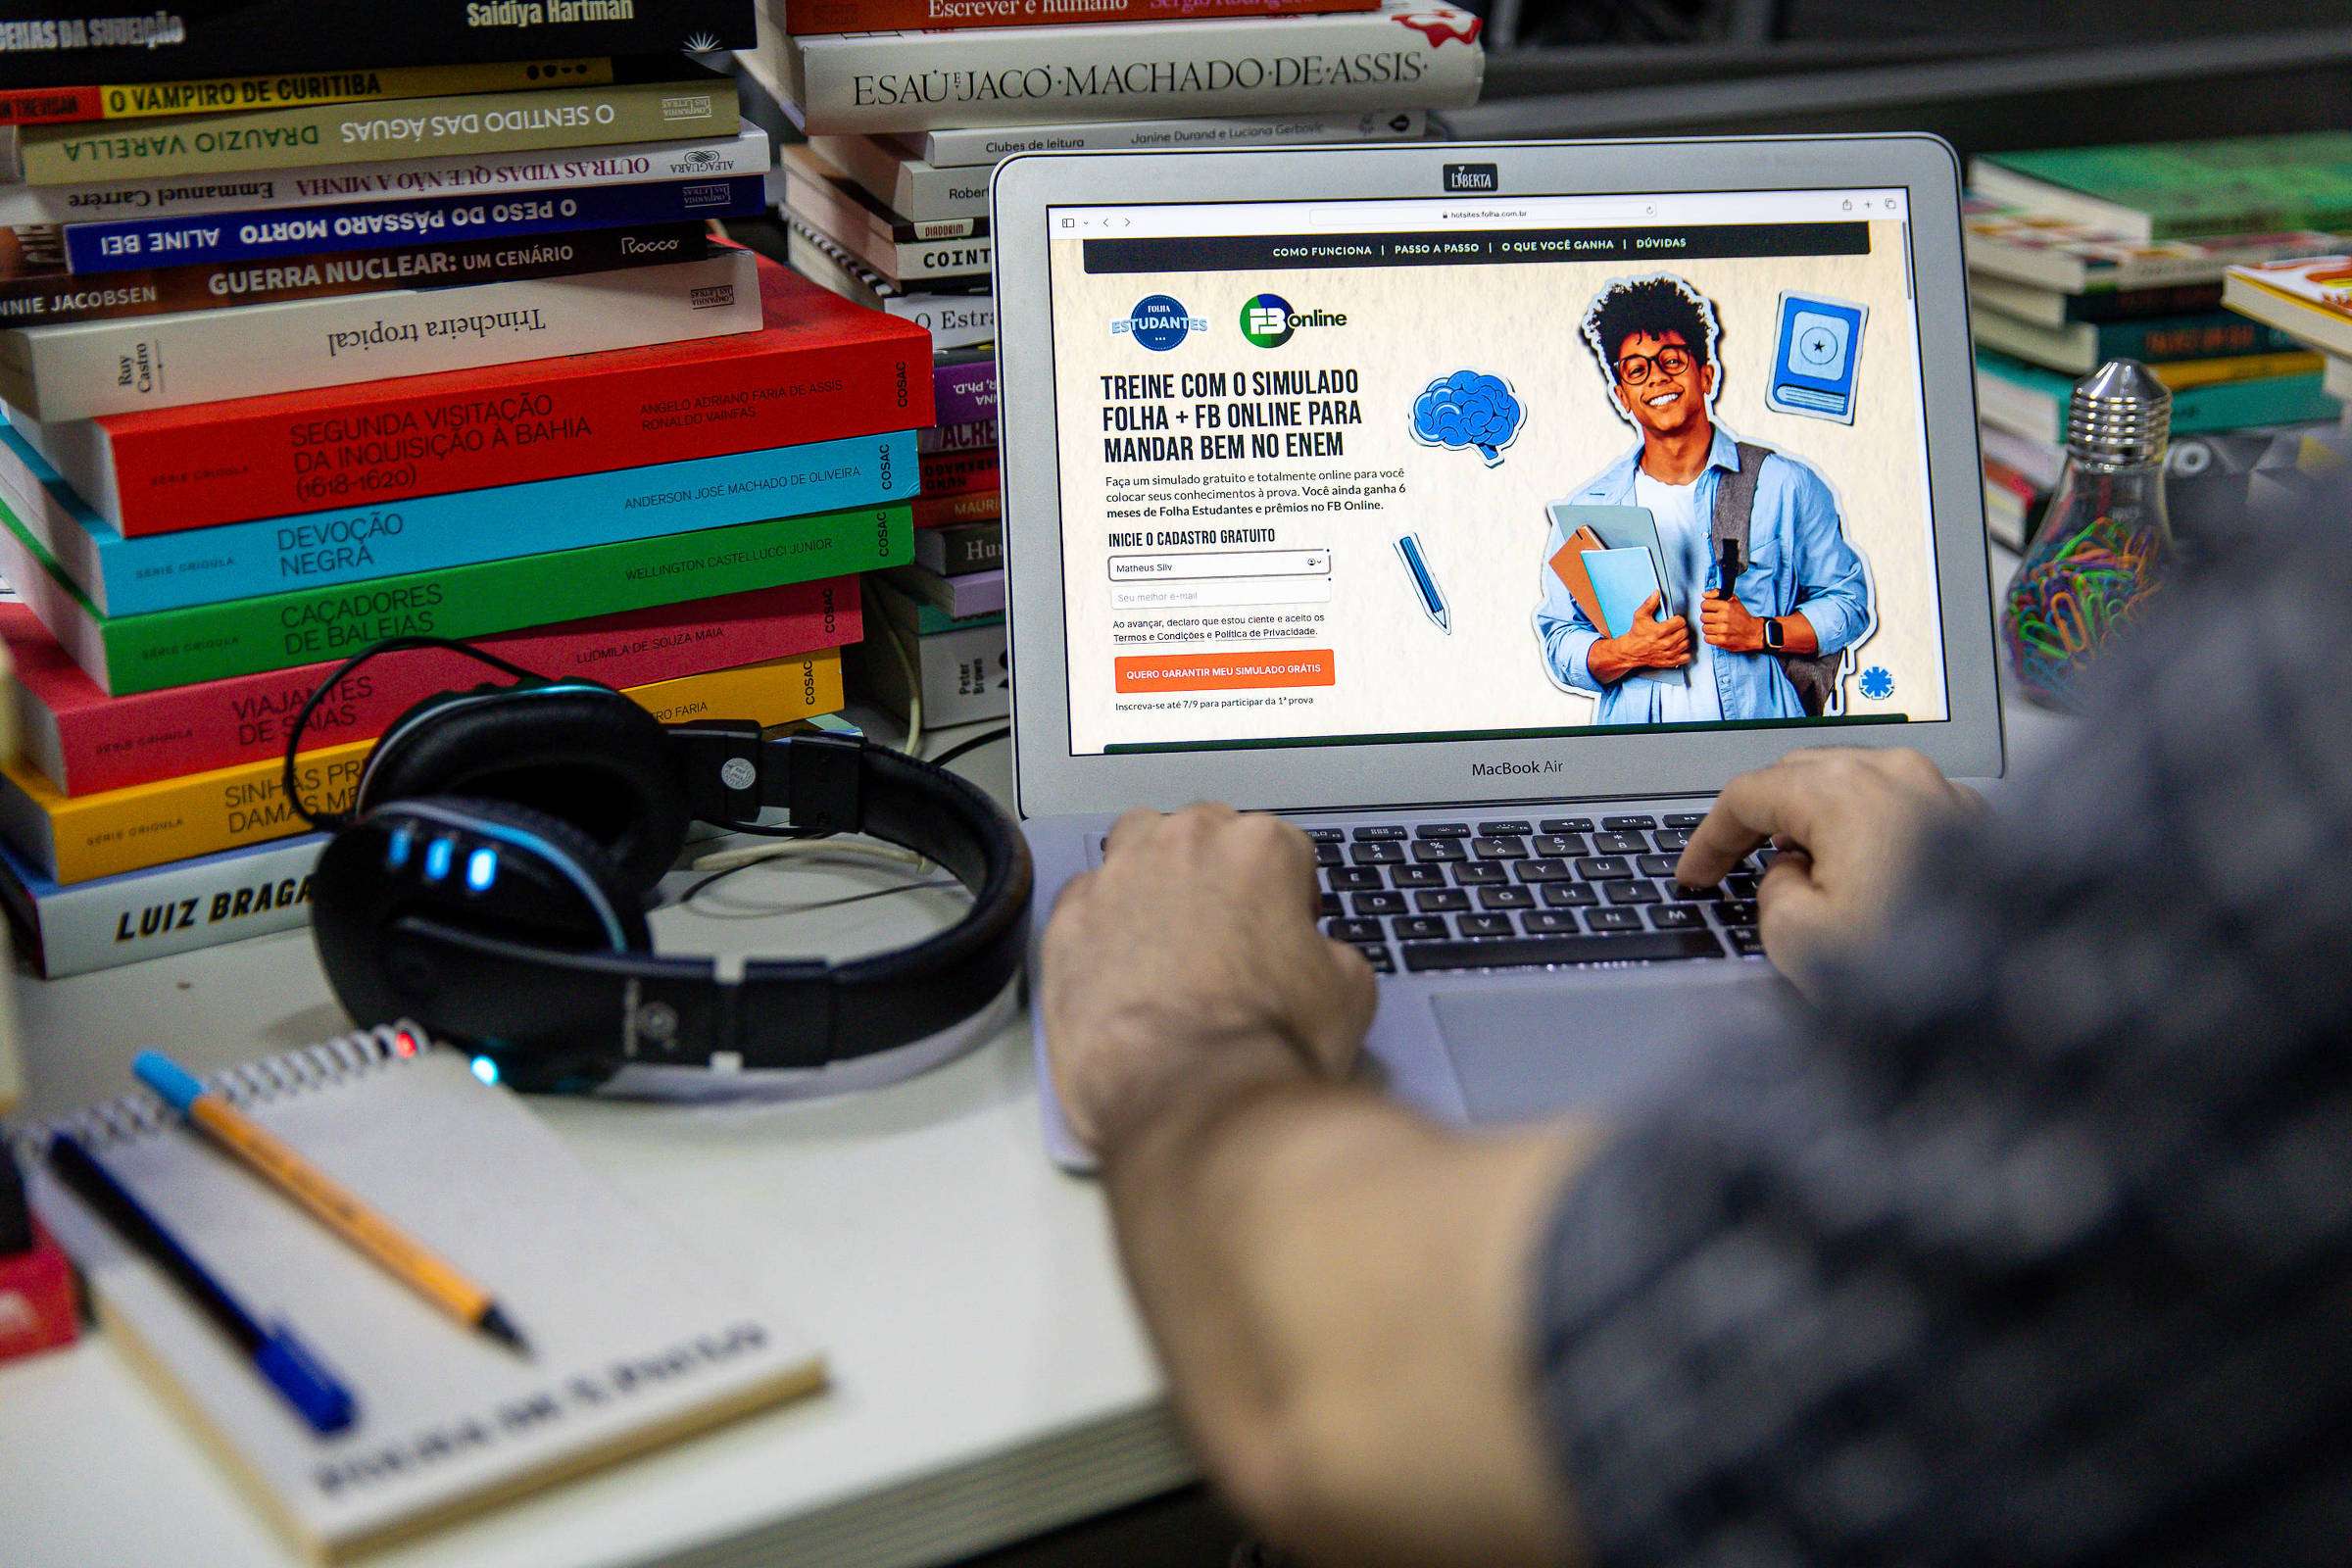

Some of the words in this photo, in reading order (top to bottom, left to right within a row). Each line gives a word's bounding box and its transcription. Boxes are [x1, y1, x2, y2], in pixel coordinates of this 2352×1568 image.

[467, 0, 542, 28] Saidiya
[548, 0, 634, 24] Hartman
[928, 0, 1020, 19] Escrever
[1063, 57, 1264, 96] MACHADO
[1275, 55, 1323, 87] DE
[1330, 51, 1422, 84] ASSIS
[110, 90, 125, 113] O
[134, 84, 235, 110] VAMPIRO
[241, 80, 271, 103] DE
[280, 74, 381, 100] CURITIBA
[432, 114, 477, 136] DAS
[485, 105, 590, 131] SENTIDO
[595, 104, 614, 123] O
[196, 125, 318, 153] DRAUZIO
[341, 120, 424, 144] ÁGUAS
[1174, 127, 1216, 141] Durand
[1229, 124, 1273, 137] Luciana
[63, 137, 186, 161] VARELLA
[986, 140, 1025, 153] Clubes
[1046, 137, 1084, 149] leitura
[450, 168, 491, 186] QUE
[498, 164, 560, 182] VIDAS
[564, 158, 649, 179] OUTRAS
[156, 182, 273, 202] Emmanuel
[298, 175, 370, 196] MINHA
[398, 171, 441, 192] NÃO
[334, 208, 444, 236] PÁSSARO
[452, 207, 485, 224] DO
[492, 201, 553, 222] PESO
[149, 227, 220, 252] ALINE
[239, 220, 326, 244] MORTO
[925, 223, 964, 237] DIADORIM
[101, 234, 140, 256] BEI
[621, 236, 679, 255] Rocco
[1272, 248, 1308, 257] COMO
[1311, 246, 1372, 257] FUNCIONA
[1395, 244, 1430, 254] PASSO
[1445, 243, 1480, 253] PASSO
[1513, 242, 1538, 252] QUE
[1541, 239, 1571, 251] VOCÊ
[1574, 240, 1614, 251] GANHA
[1636, 237, 1687, 249] DÚVIDAS
[208, 265, 324, 296] GUERRA
[325, 252, 457, 285] NUCLEAR:
[463, 254, 491, 270] UM
[495, 244, 573, 268] CENÁRIO
[50, 286, 157, 313] JACOBSEN
[426, 308, 546, 341] Trincheira
[1111, 316, 1208, 334] ESTUDANTES
[1288, 309, 1348, 328] online
[327, 318, 419, 357] tropical
[118, 355, 134, 387] Ruy
[136, 342, 152, 393] Castro
[896, 361, 907, 409] COSAC
[952, 380, 983, 395] Ph.D.
[1101, 374, 1175, 400] TREINE
[1181, 372, 1226, 398] COM
[1233, 371, 1246, 397] O
[1252, 368, 1358, 396] SIMULADO
[640, 399, 692, 416] ANGELO
[694, 391, 750, 409] ADRIANO
[752, 386, 787, 403] FARIA
[290, 410, 418, 448] SEGUNDA
[425, 391, 553, 429] VISITAÇÃO
[642, 413, 703, 431] RONALDO
[706, 406, 757, 425] VAINFAS
[1102, 405, 1169, 431] FOLHA
[1196, 404, 1221, 428] FB
[1227, 402, 1301, 427] ONLINE
[1309, 400, 1362, 425] PARA
[294, 449, 332, 475] DA
[338, 426, 483, 468] INQUISIÇÃO
[515, 416, 592, 446] BAHIA
[1104, 435, 1194, 463] MANDAR
[1200, 434, 1246, 460] BEM
[1251, 433, 1279, 458] NO
[1286, 431, 1344, 458] ENEM
[880, 444, 891, 490] COSAC
[1105, 476, 1130, 488] Faça
[1152, 474, 1200, 485] simulado
[1202, 473, 1246, 485] gratuito
[1257, 471, 1316, 482] totalmente
[1318, 470, 1351, 480] online
[1354, 469, 1377, 480] para
[1380, 468, 1404, 478] você
[296, 466, 416, 503] (1618-1620)
[624, 489, 692, 510] ANDERSON
[695, 482, 725, 501] JOSÉ
[728, 474, 788, 497] MACHADO
[808, 466, 860, 484] OLIVEIRA
[1105, 492, 1145, 503] colocar
[1174, 489, 1255, 501] conhecimentos
[1267, 489, 1299, 499] prova.
[1302, 486, 1329, 496] Você
[1332, 484, 1361, 496] ainda
[1364, 484, 1396, 496] ganha
[1106, 509, 1141, 518] meses
[1159, 506, 1190, 516] Folha
[1192, 505, 1252, 515] Estudantes
[1264, 502, 1308, 514] prêmios
[1327, 501, 1342, 511] FB
[1344, 500, 1384, 511] Online.
[277, 511, 404, 551] DEVOÇÃO
[878, 512, 889, 557] COSAC
[1108, 532, 1143, 548] INICIE
[1156, 530, 1216, 546] CADASTRO
[1220, 528, 1275, 544] GRATUITO
[281, 545, 373, 578] NEGRA
[625, 558, 705, 581] WELLINGTON
[708, 544, 787, 568] CASTELLUCCI
[790, 538, 833, 556] JUNIOR
[1116, 564, 1155, 573] Matheus
[281, 583, 443, 629] CAÇADORES
[1166, 616, 1200, 627] declaro
[1201, 618, 1219, 628] que
[1221, 616, 1246, 625] estou
[1248, 614, 1274, 624] ciente
[1285, 613, 1311, 622] aceito
[285, 631, 320, 656] DE
[328, 612, 434, 649] BALEIAS
[577, 646, 630, 664] LUDMILA
[652, 633, 693, 651] SOUZA
[695, 626, 724, 643] MAIA
[1113, 633, 1147, 642] Termos
[1157, 630, 1204, 641] Condições
[1214, 629, 1248, 639] Política
[1263, 627, 1318, 637] Privacidade.
[1127, 669, 1159, 680] QUERO
[1161, 668, 1210, 678] GARANTIR
[1211, 667, 1233, 676] MEU
[1236, 665, 1285, 676] SIMULADO
[1287, 662, 1321, 673] GRÁTIS
[232, 676, 373, 720] VIAJATES
[1115, 702, 1165, 710] Inscreva-se
[1221, 698, 1263, 708] participar
[1289, 697, 1313, 706] prova
[1472, 760, 1541, 776] MacBook
[1544, 760, 1563, 773] Air
[1412, 870, 1423, 879] R
[1475, 867, 1484, 876] T
[116, 896, 200, 943] LUIZ
